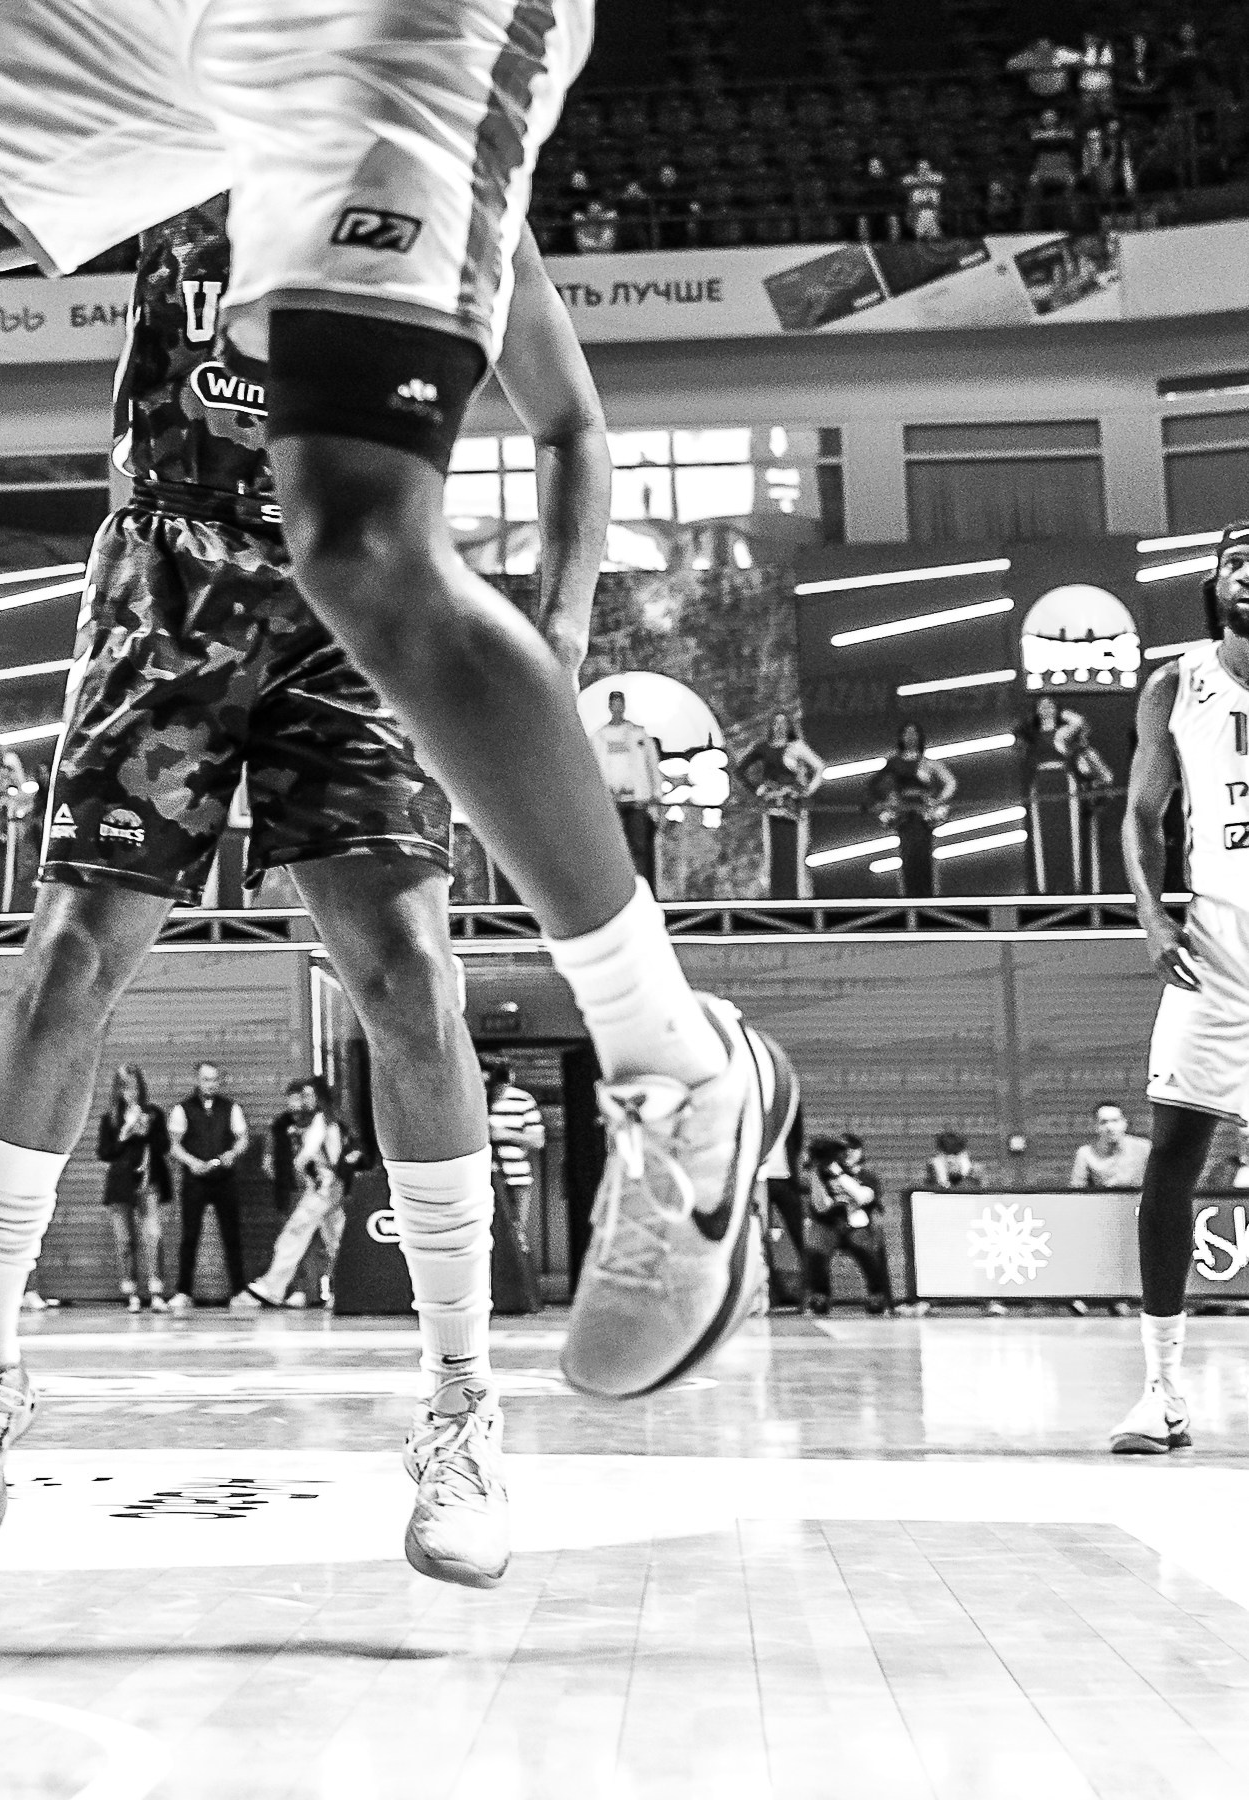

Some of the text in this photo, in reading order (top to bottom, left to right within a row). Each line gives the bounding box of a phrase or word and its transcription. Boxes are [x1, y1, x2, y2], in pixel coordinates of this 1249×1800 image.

[554, 276, 724, 307] ТЬ ЛУЧШЕ
[69, 302, 130, 329] БАН
